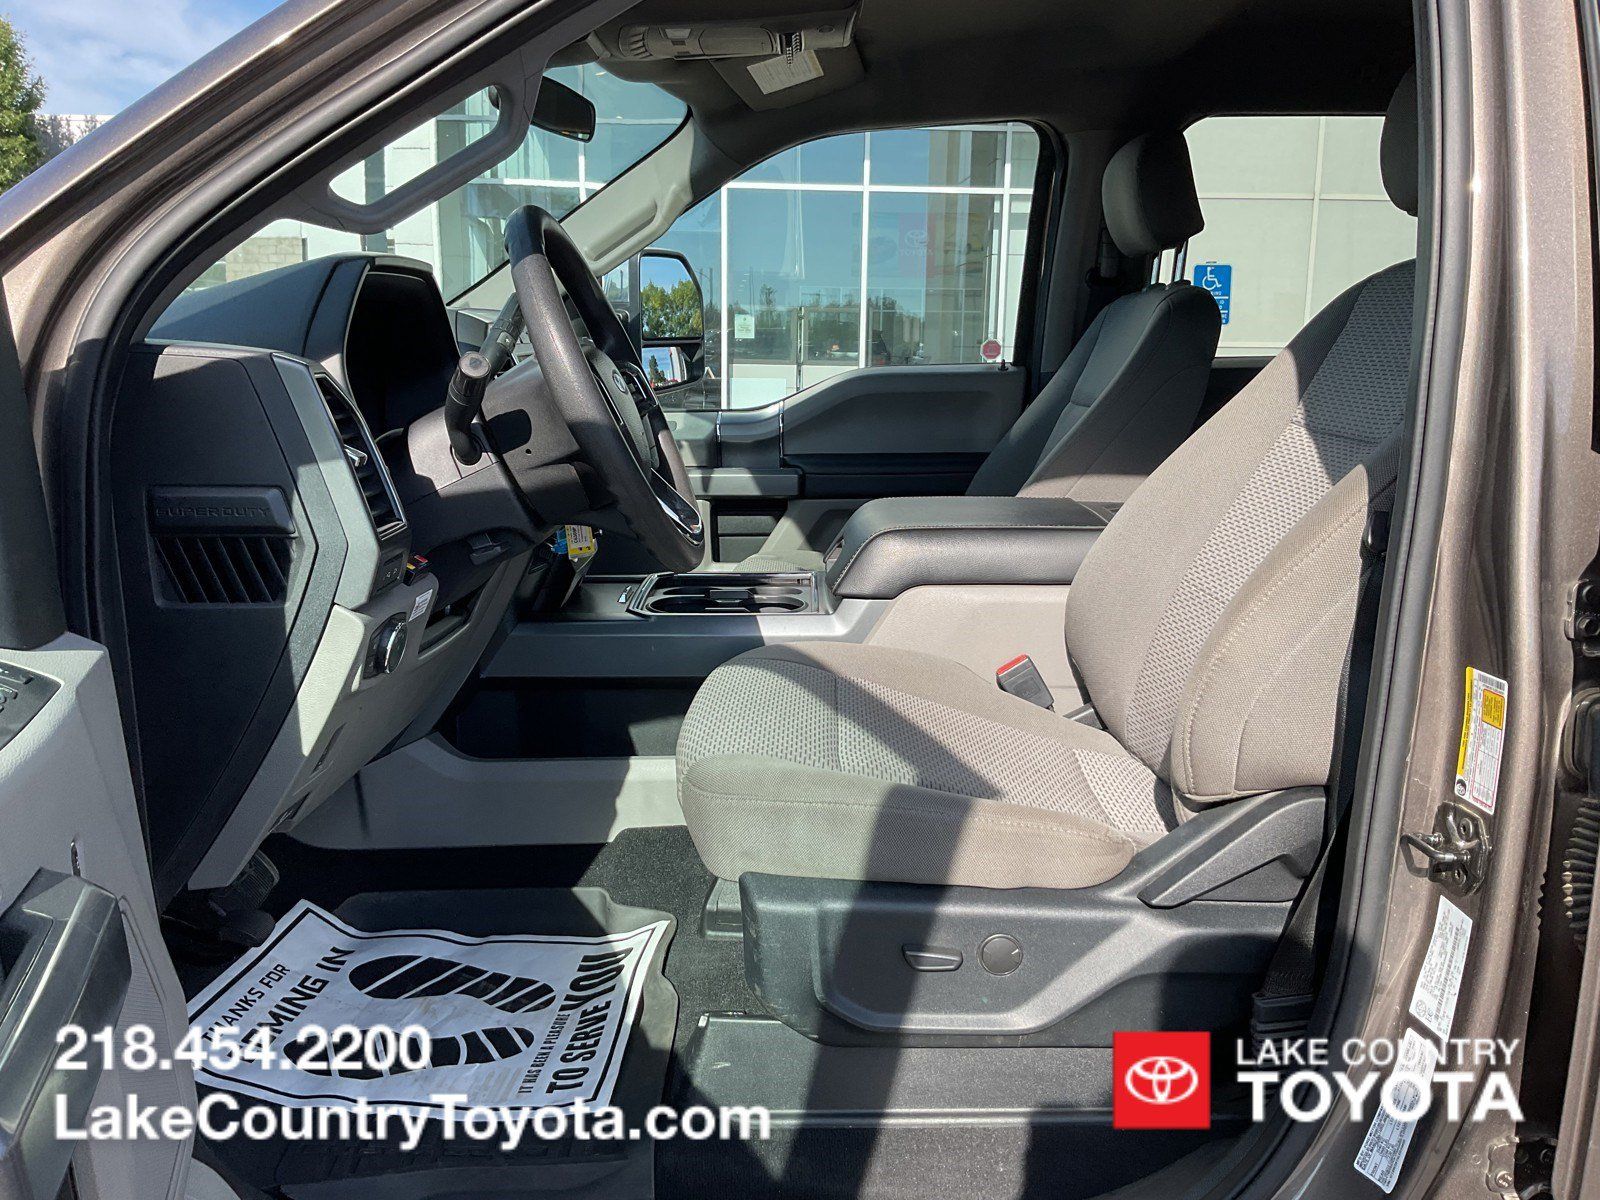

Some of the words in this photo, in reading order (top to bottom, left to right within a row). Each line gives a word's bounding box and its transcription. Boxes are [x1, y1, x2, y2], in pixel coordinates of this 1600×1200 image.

[155, 506, 219, 518] SUPER
[221, 506, 271, 518] DUTY
[315, 946, 356, 973] IN
[259, 963, 291, 989] FOR
[558, 946, 634, 1012] YOU
[543, 1013, 571, 1045] PLEASURE
[559, 999, 612, 1064] SERVE
[530, 1051, 551, 1068] BEEN
[522, 1068, 543, 1084] HAS
[545, 1066, 590, 1094] TO
[517, 1085, 534, 1094] IT
